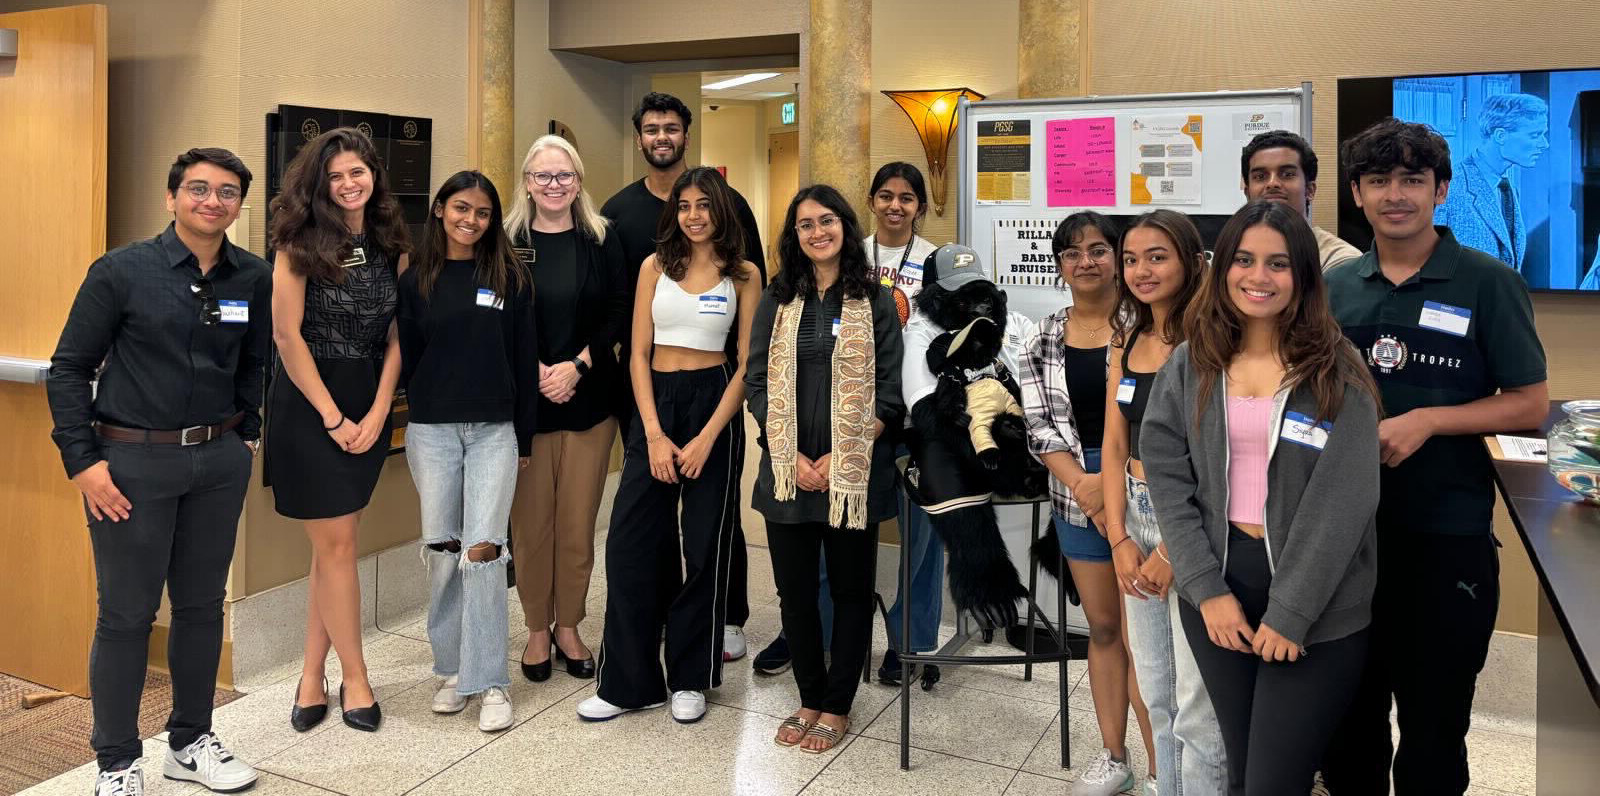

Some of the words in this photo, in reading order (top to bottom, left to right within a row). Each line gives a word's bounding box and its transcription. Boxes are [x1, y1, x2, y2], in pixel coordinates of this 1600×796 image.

[993, 121, 1014, 133] PGSG
[1017, 230, 1053, 240] RILLA
[1030, 242, 1038, 250] &
[953, 252, 976, 269] P
[1021, 254, 1054, 263] BABY
[1412, 352, 1461, 368] TROPEZ
